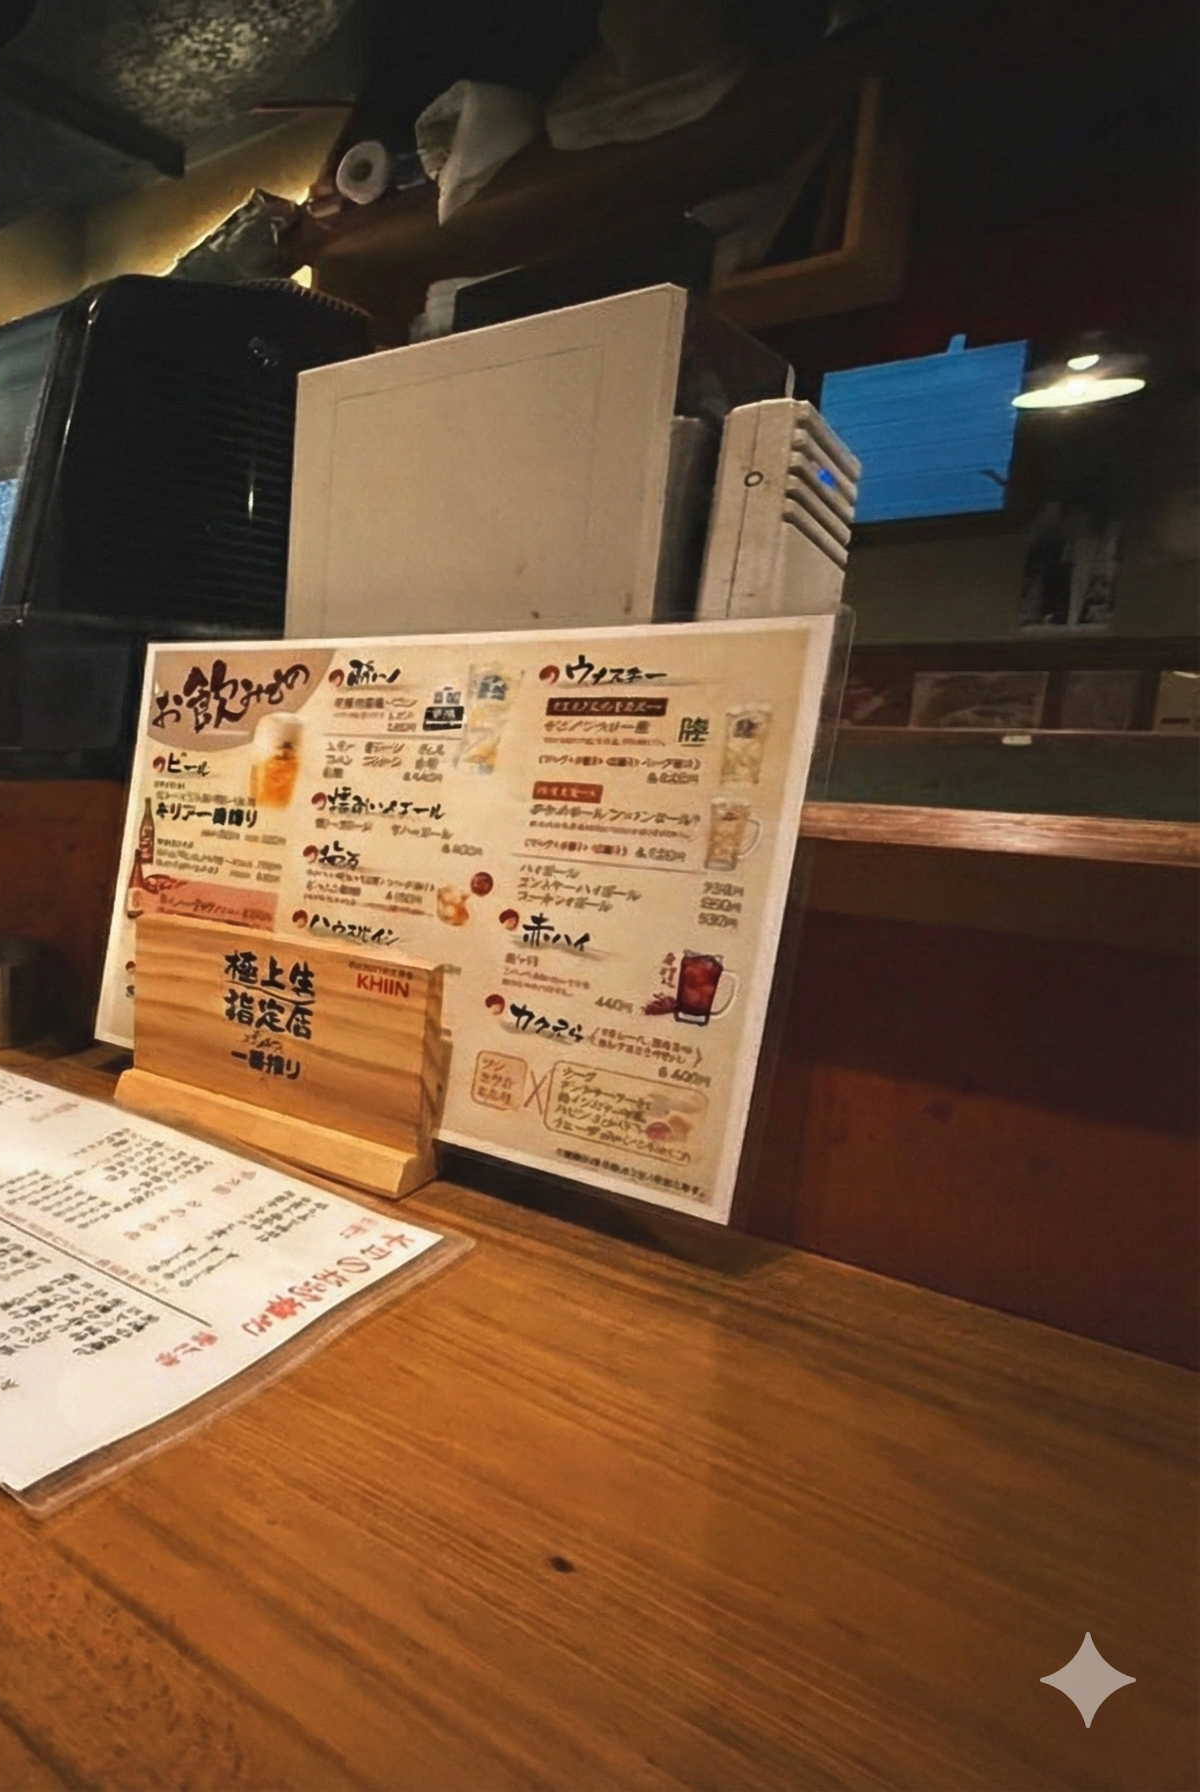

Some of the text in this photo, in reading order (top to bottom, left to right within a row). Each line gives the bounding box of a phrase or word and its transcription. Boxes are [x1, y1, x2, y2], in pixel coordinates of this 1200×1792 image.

[522, 912, 591, 951] 赤ハイ
[224, 949, 316, 998] 極上生
[356, 973, 410, 998] KHIIN
[223, 988, 314, 1040] 指定店
